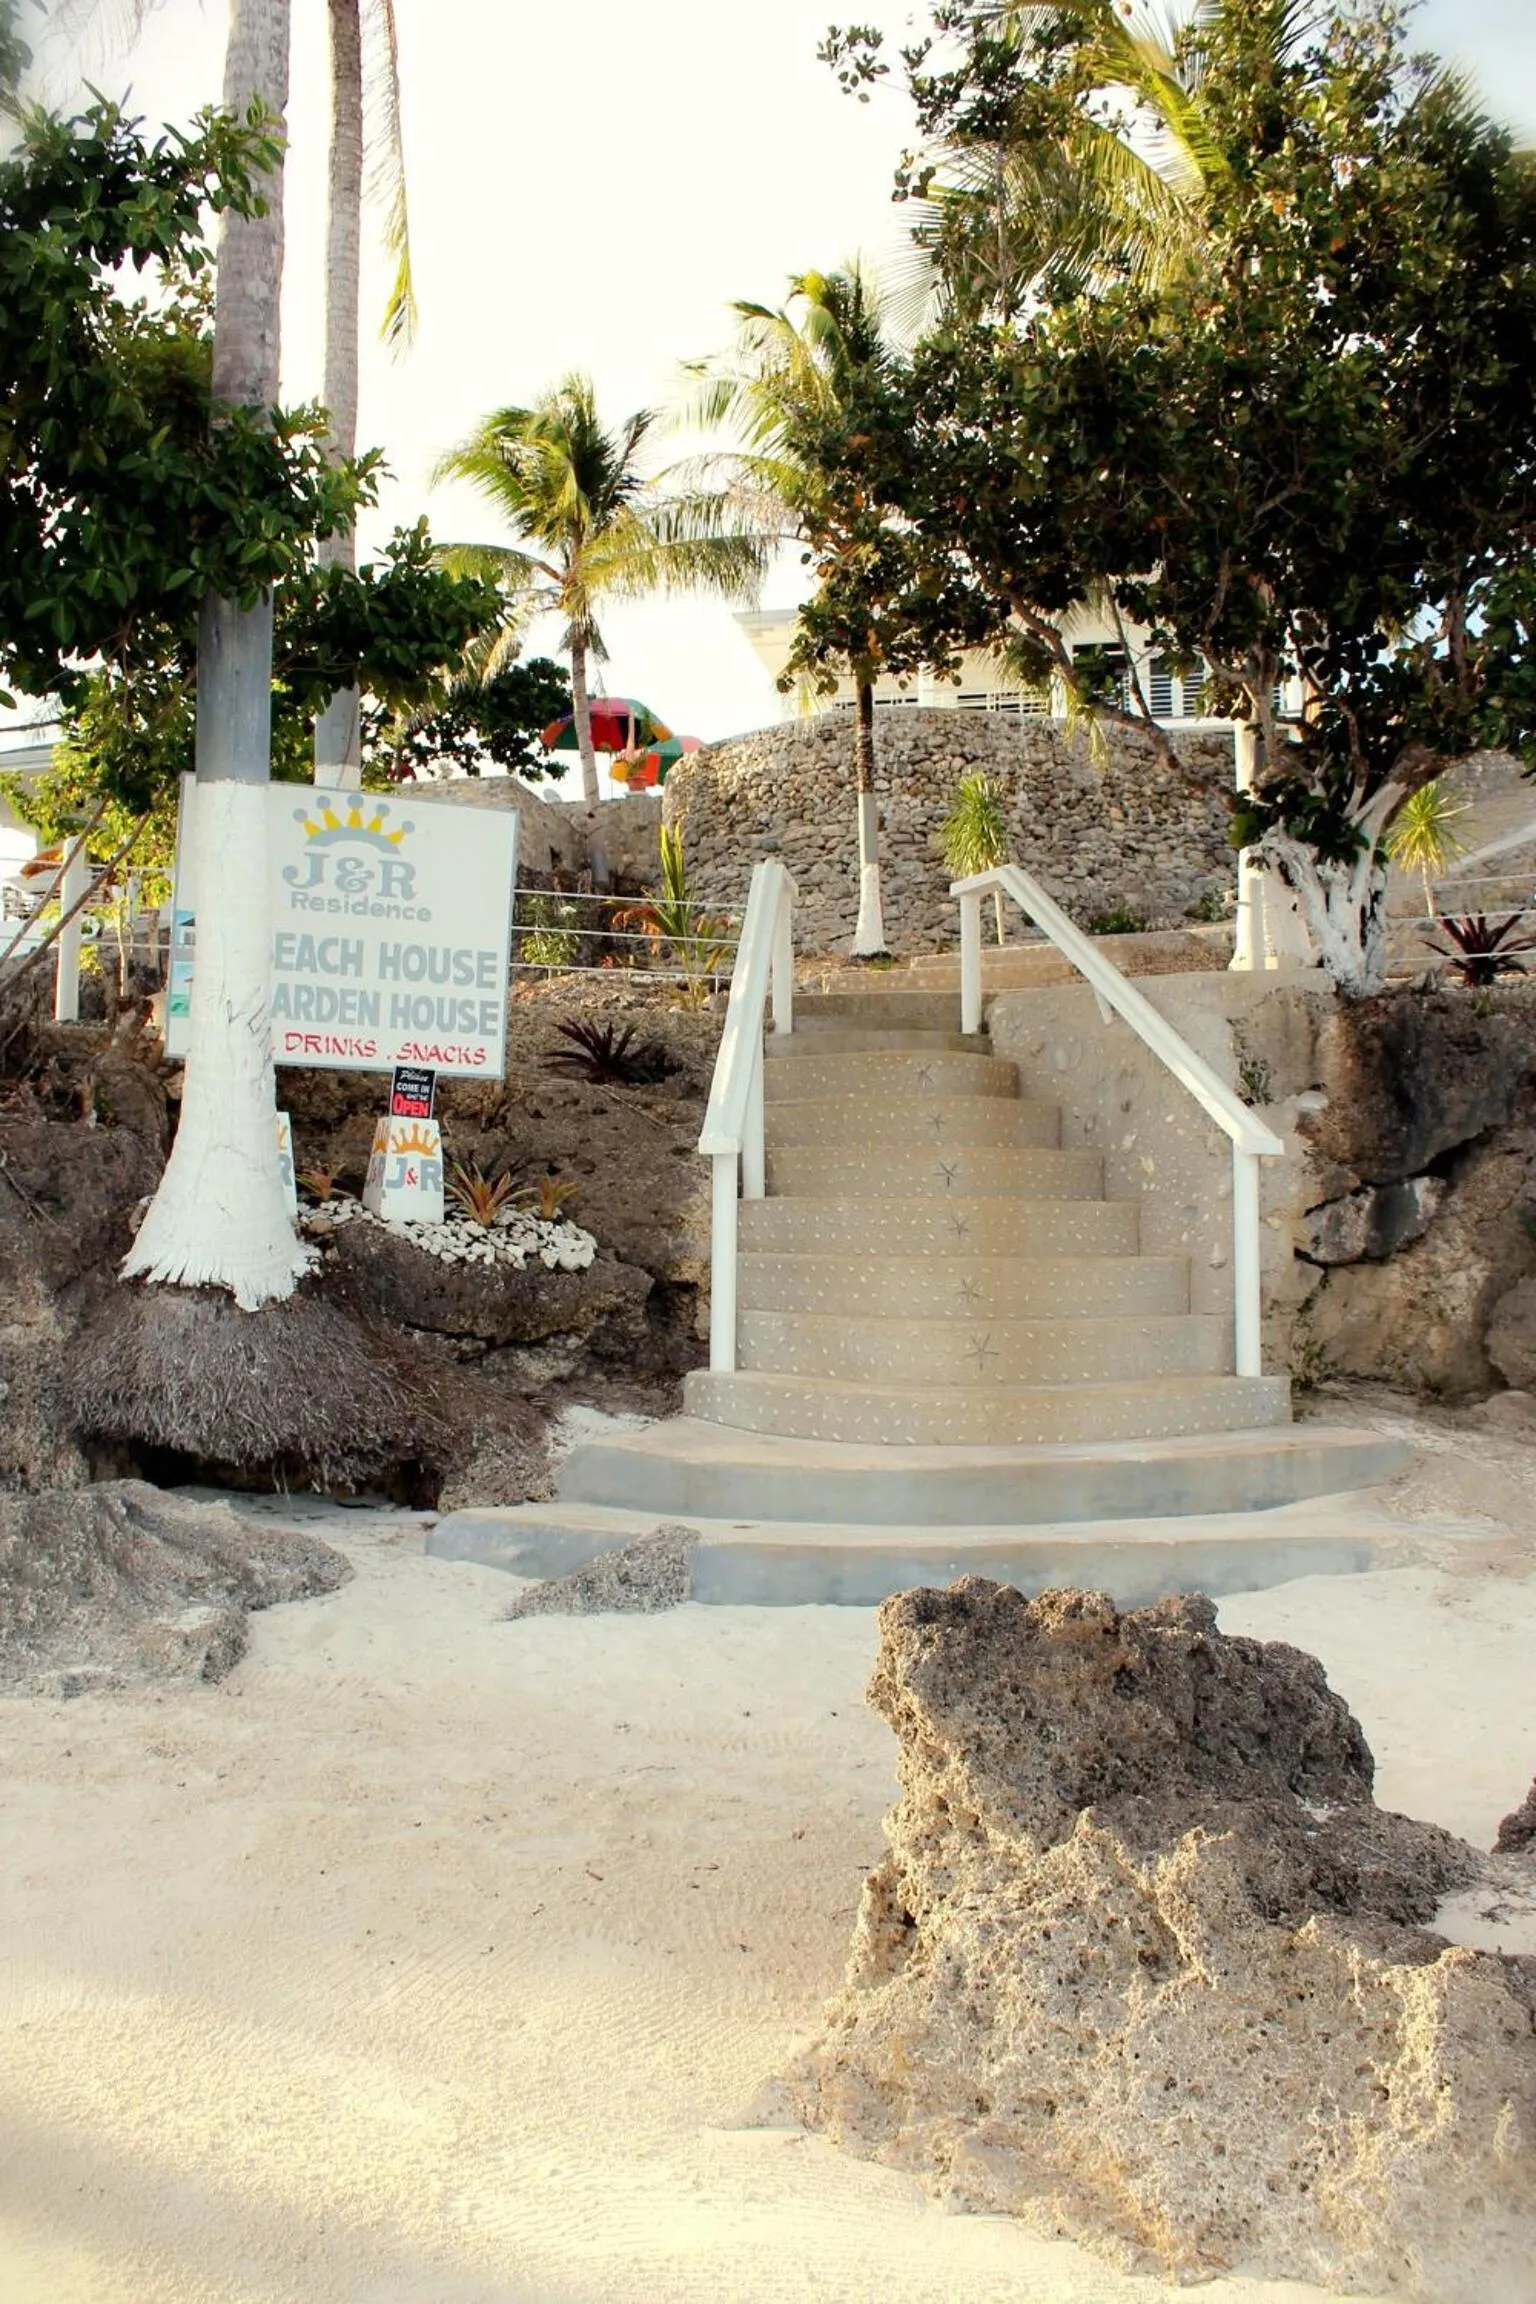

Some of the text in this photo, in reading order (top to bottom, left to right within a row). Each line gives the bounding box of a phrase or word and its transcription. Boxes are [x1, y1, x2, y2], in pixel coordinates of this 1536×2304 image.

[282, 851, 417, 901] J&R
[290, 890, 432, 923] Residence
[273, 932, 498, 989] EACH HOUSE
[272, 982, 500, 1037] ARDEN HOUSE
[285, 1032, 378, 1058] DRINKS
[396, 1082, 431, 1094] COME IN
